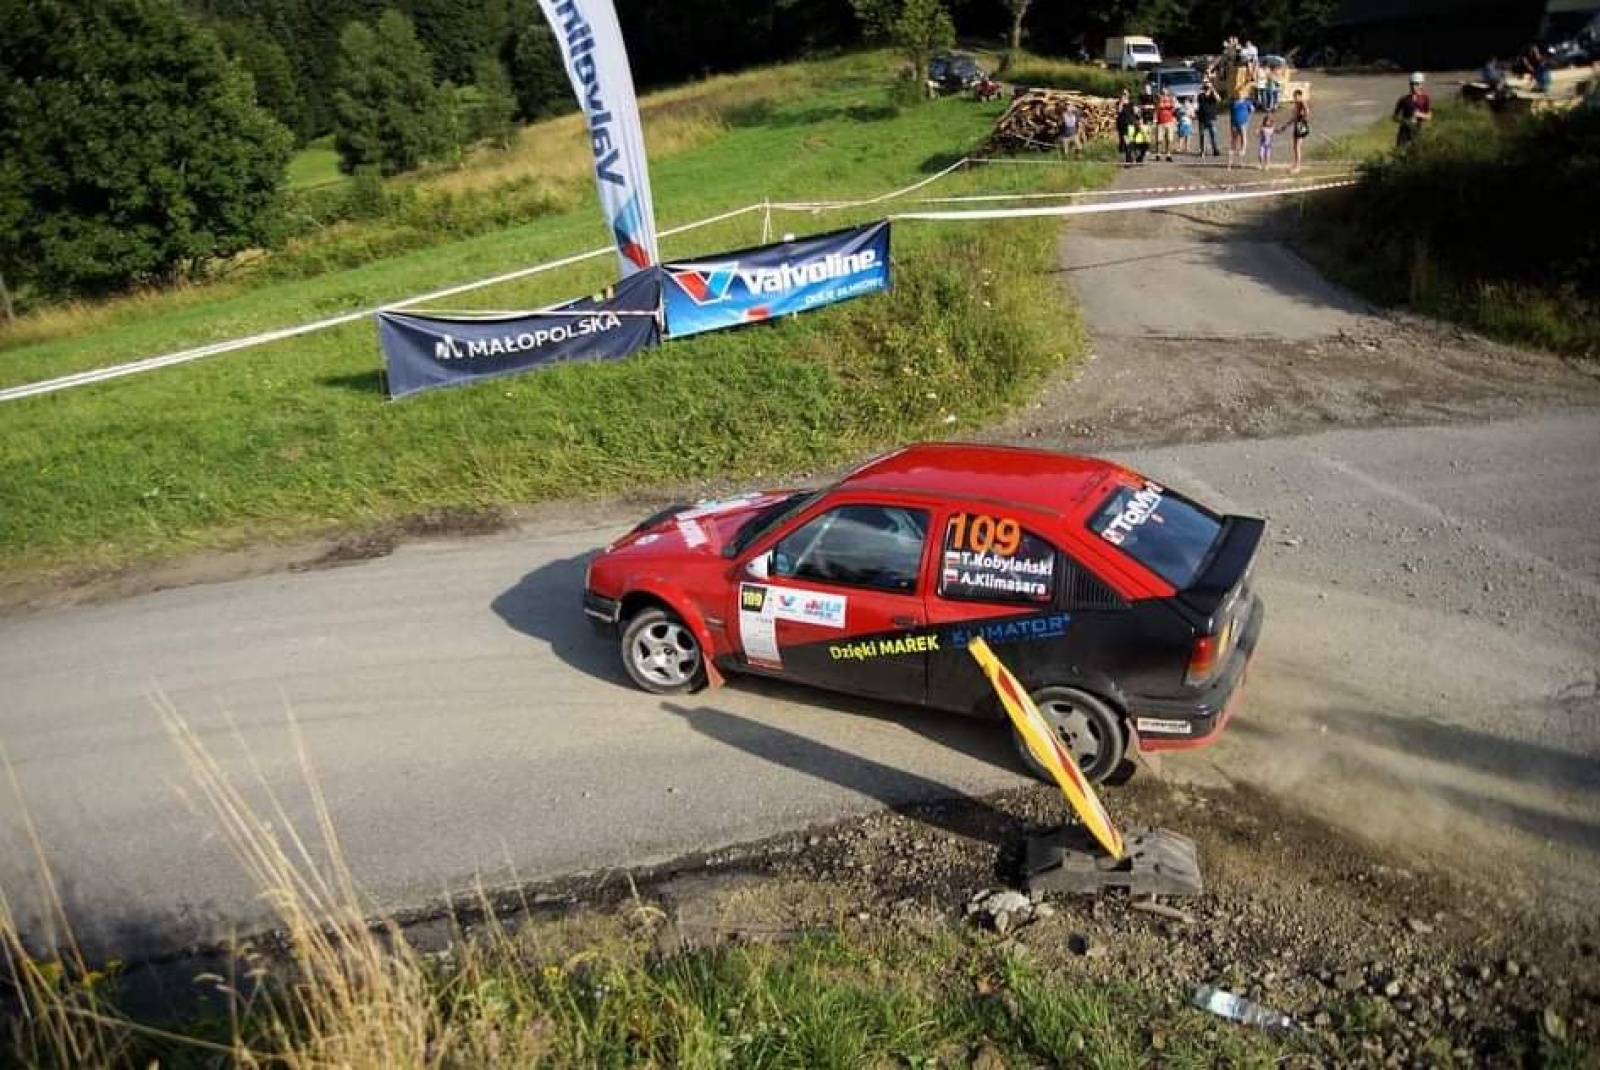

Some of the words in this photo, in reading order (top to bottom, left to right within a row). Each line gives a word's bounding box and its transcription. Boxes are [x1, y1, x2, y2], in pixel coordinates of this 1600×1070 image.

[739, 249, 881, 295] Valvoline
[468, 311, 622, 358] MAŁOPOLSKA
[949, 512, 1021, 556] 109
